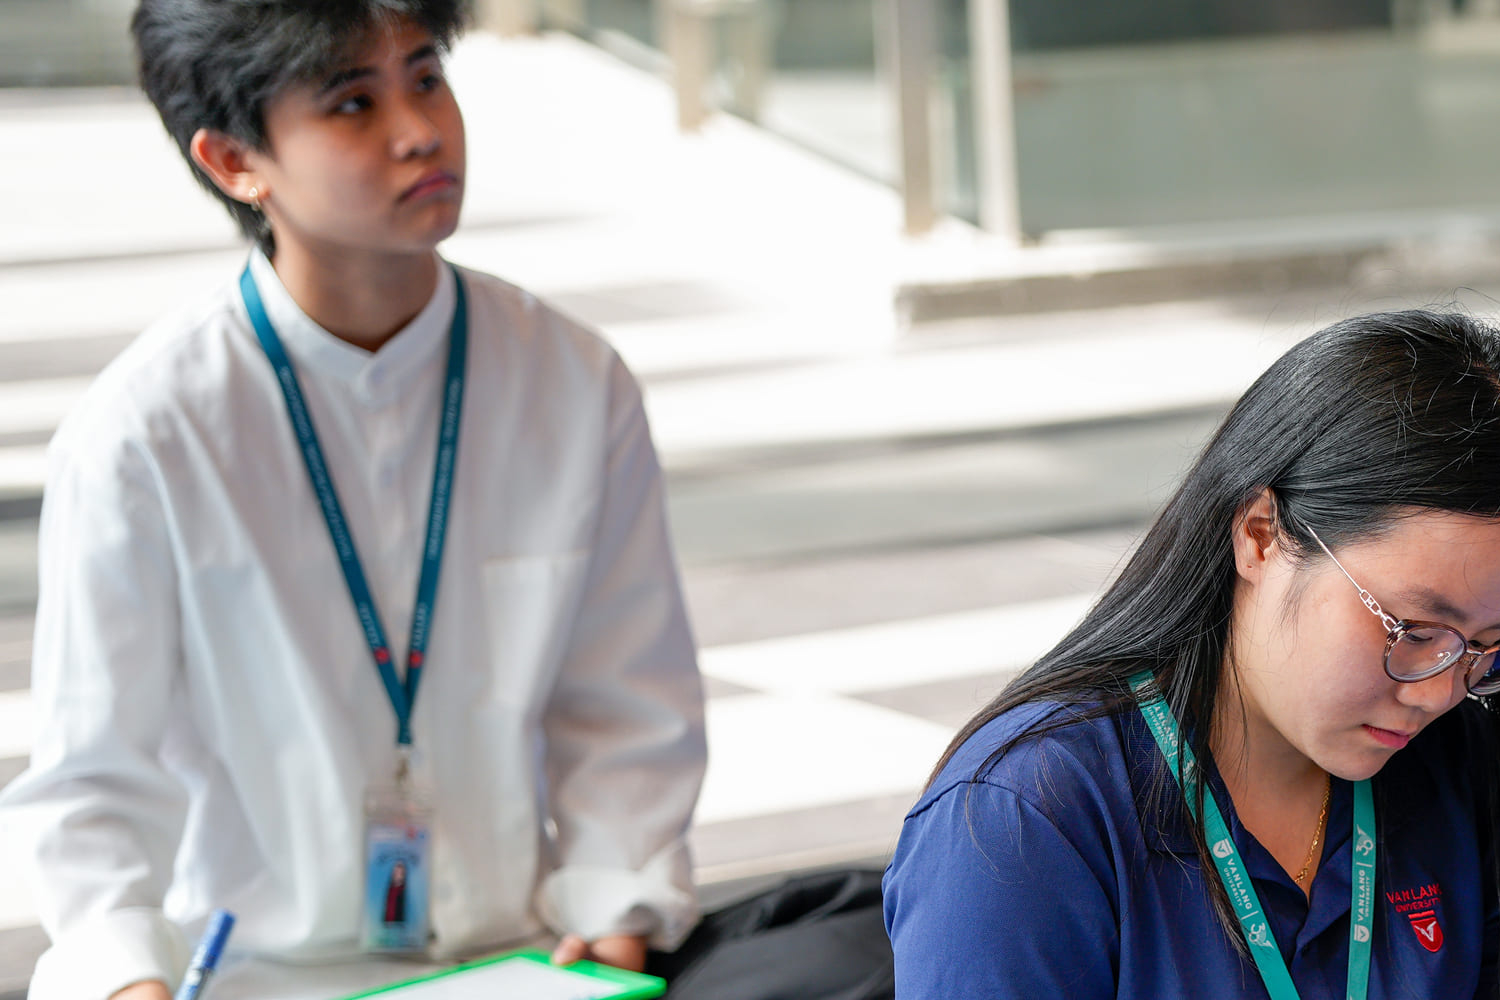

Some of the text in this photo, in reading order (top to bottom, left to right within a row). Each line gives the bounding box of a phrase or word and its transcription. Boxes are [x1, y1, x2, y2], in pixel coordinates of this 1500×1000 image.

[1223, 867, 1243, 907] UNIVERSITY
[1227, 858, 1253, 910] VANLANG
[1358, 869, 1366, 922] VANLANG
